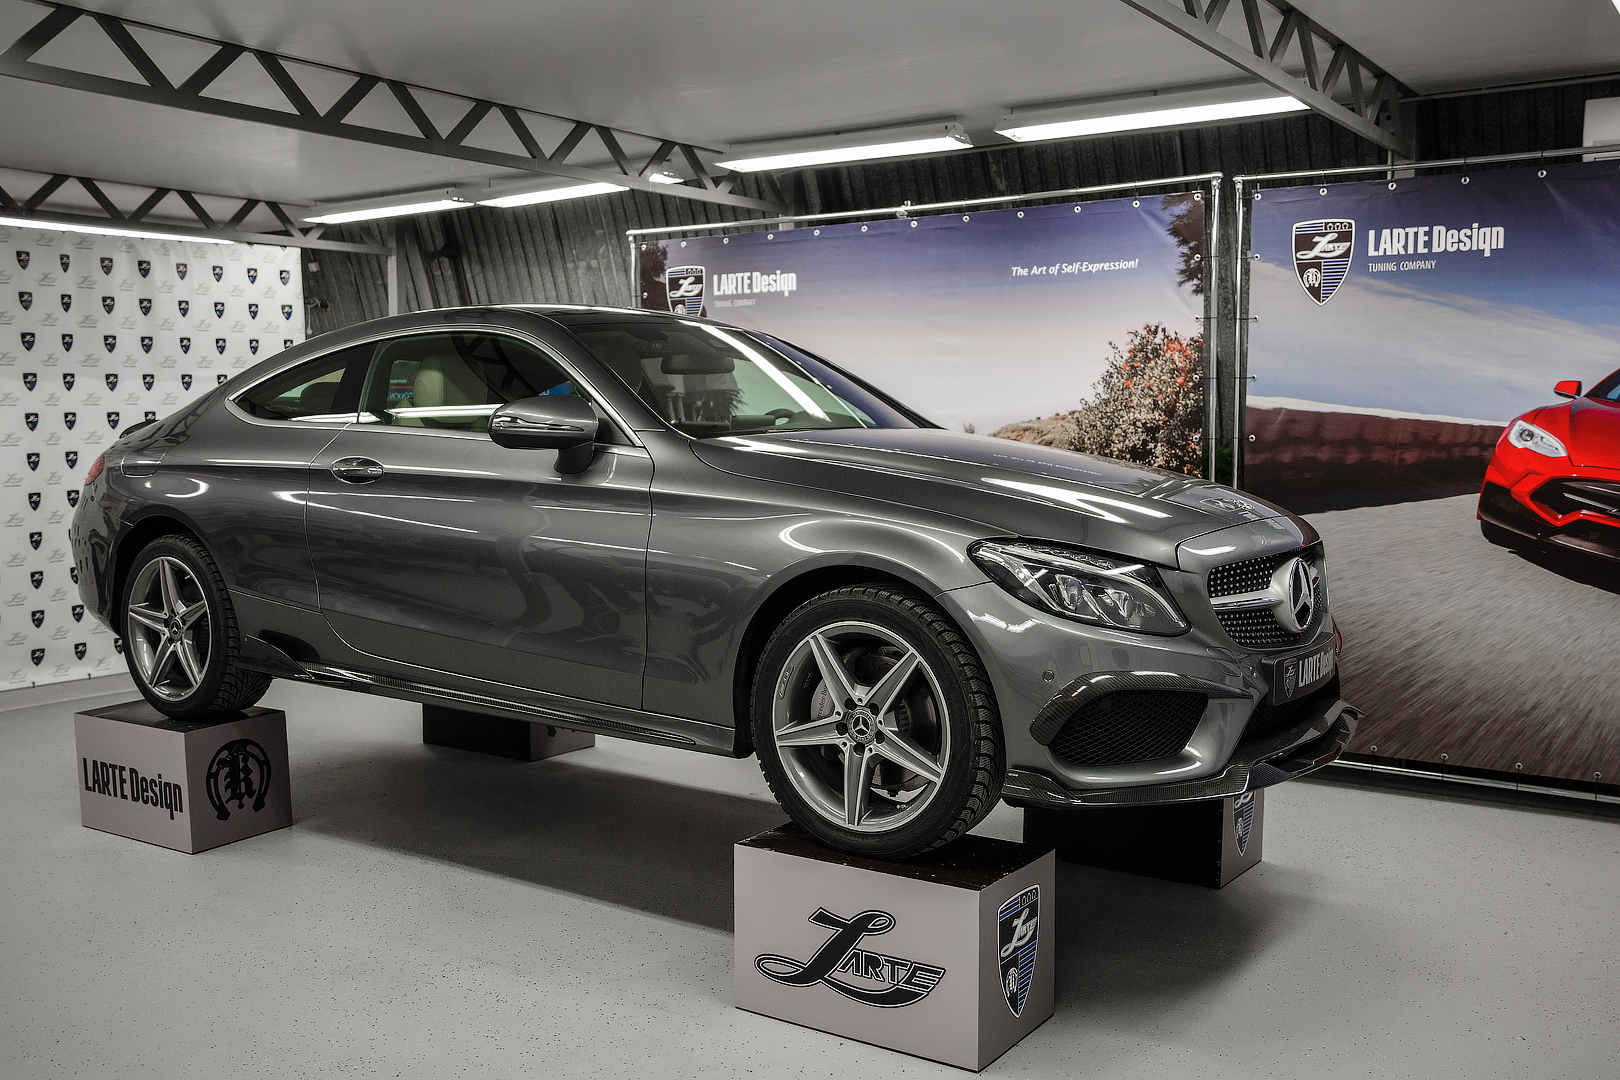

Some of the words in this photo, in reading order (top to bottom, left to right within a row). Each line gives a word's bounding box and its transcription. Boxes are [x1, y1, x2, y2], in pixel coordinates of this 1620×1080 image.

[1368, 226, 1429, 256] LARTE
[1431, 223, 1505, 257] Design
[713, 272, 751, 296] LARTE
[752, 269, 797, 297] Design
[1011, 266, 1029, 277] The
[1030, 265, 1047, 275] Art
[1048, 263, 1061, 276] of
[1061, 258, 1139, 275] Self-Expression!
[1368, 262, 1397, 272] TUNING
[1399, 260, 1437, 271] COMPANY
[714, 300, 732, 308] TUNING
[733, 299, 756, 307] COMPANY
[1298, 653, 1320, 687] LARTE
[82, 757, 129, 801] LARTE
[129, 766, 184, 821] Design
[1000, 907, 1038, 958] LARTE
[753, 906, 946, 1009] LARTE
